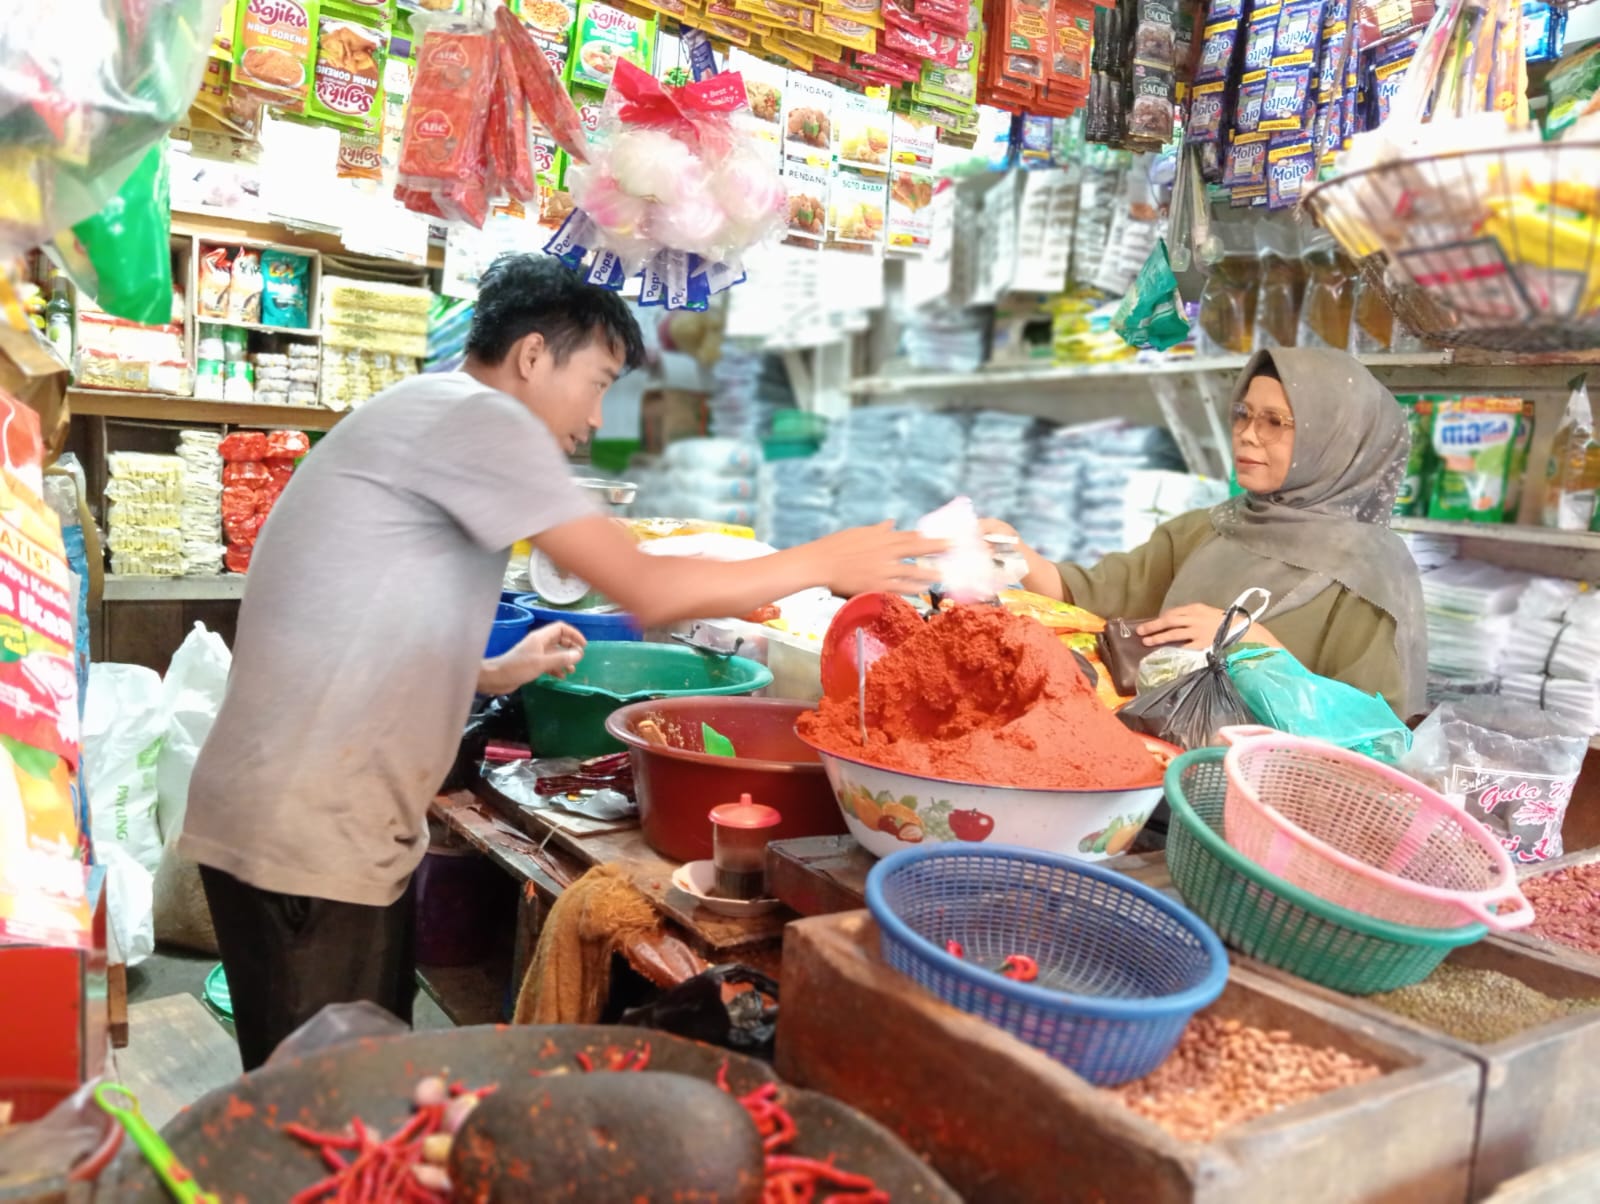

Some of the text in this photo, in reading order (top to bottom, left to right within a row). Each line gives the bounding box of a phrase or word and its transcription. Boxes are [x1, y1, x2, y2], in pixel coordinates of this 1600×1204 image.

[248, 0, 308, 28] Sajiku
[588, 4, 637, 31] Sajiku
[1279, 31, 1312, 45] Molto
[316, 83, 374, 113] Sajiku
[1265, 97, 1299, 110] Molto
[420, 121, 449, 132] ABC
[1240, 109, 1259, 123] olto
[340, 146, 382, 168] Sajiku
[1273, 165, 1309, 181] Molto
[0, 530, 50, 574] ATIS!
[1479, 782, 1539, 813] Gula
[115, 785, 129, 841] PAYUNG
